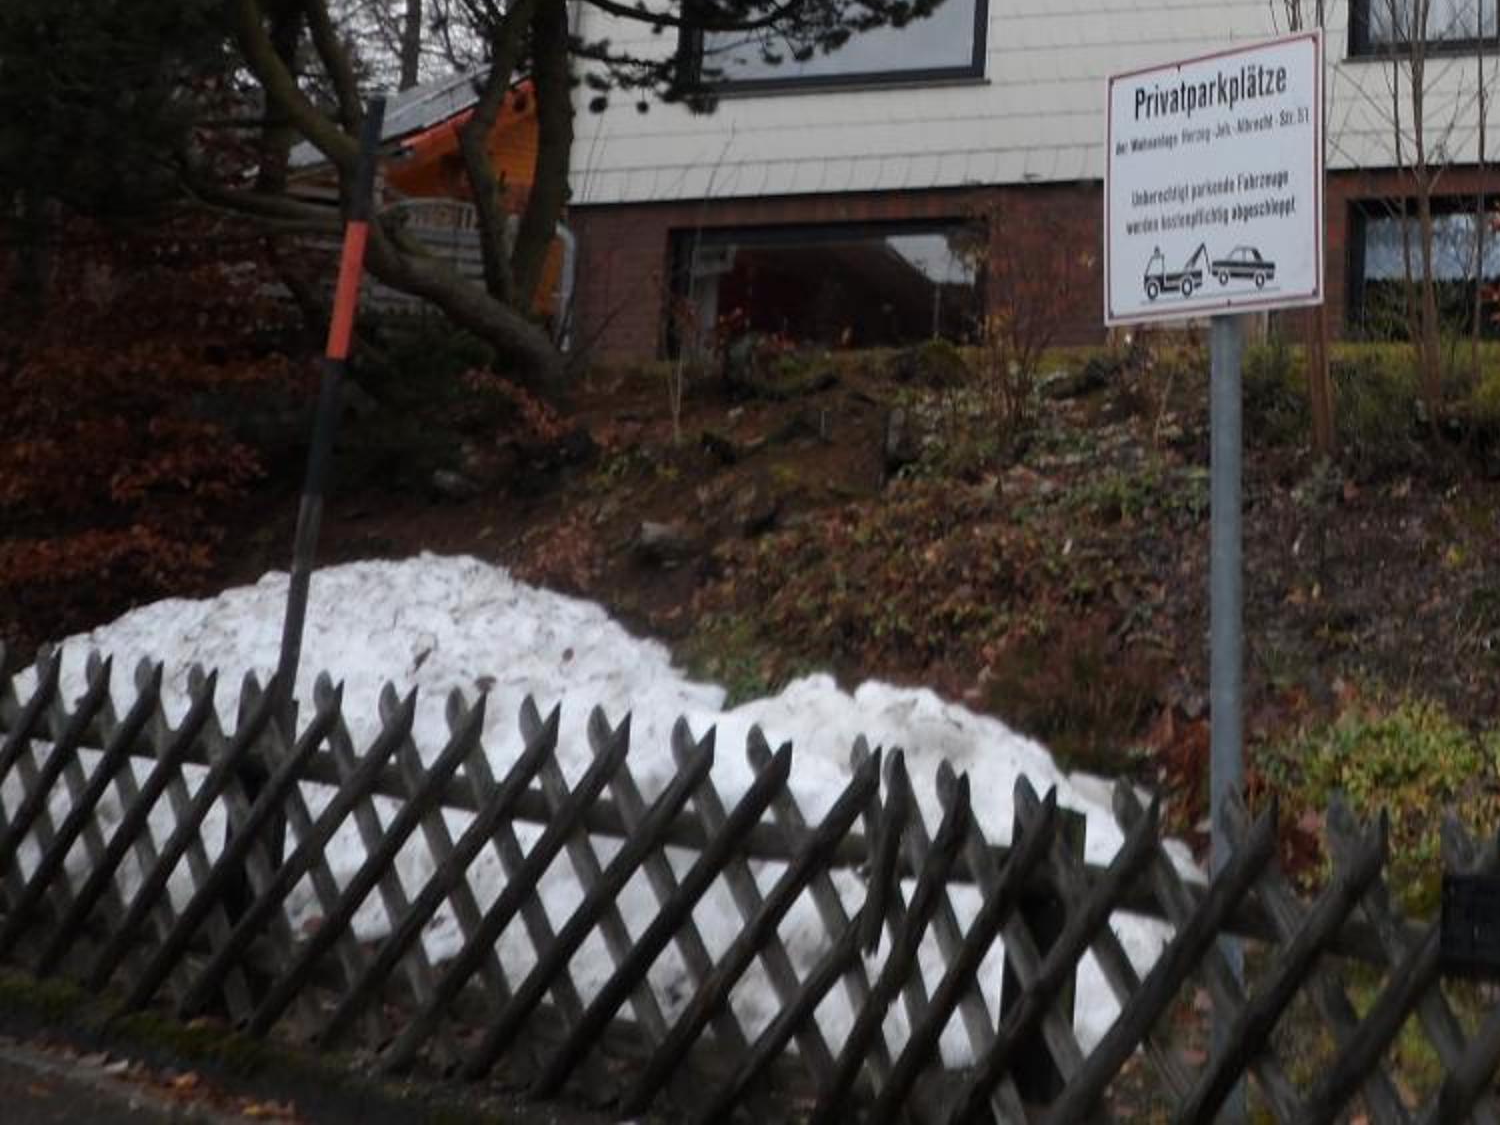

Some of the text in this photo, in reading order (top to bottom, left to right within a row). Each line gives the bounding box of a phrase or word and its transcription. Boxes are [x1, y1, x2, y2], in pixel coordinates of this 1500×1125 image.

[1135, 65, 1287, 120] Privatparkplätze
[1191, 175, 1234, 202] parkende
[1237, 170, 1289, 191] Fahrzeuge
[1126, 217, 1159, 236] werden
[1231, 195, 1296, 223] abgeschleppt
